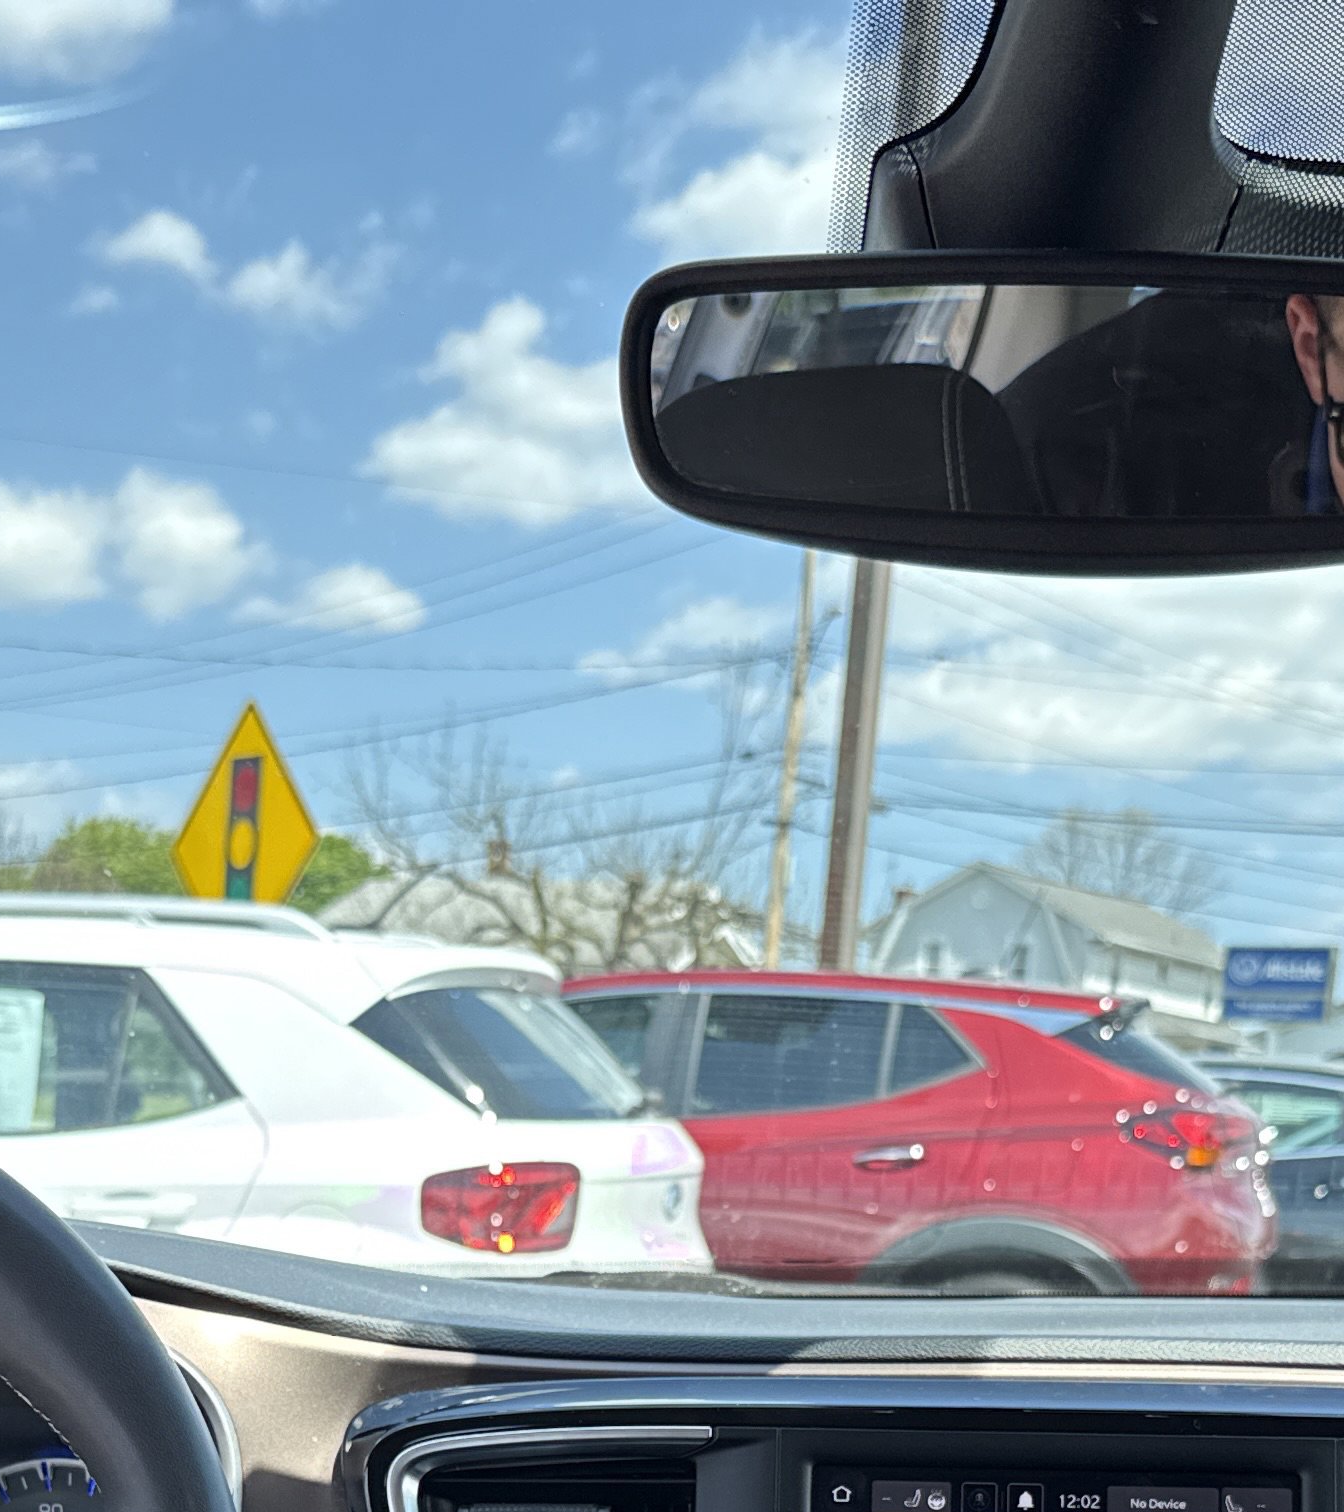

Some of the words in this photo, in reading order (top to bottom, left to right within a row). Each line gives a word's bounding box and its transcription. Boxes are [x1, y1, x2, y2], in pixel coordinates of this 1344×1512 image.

[1059, 1494, 1101, 1510] 12:02
[1130, 1498, 1146, 1510] No
[1149, 1498, 1186, 1510] Device
